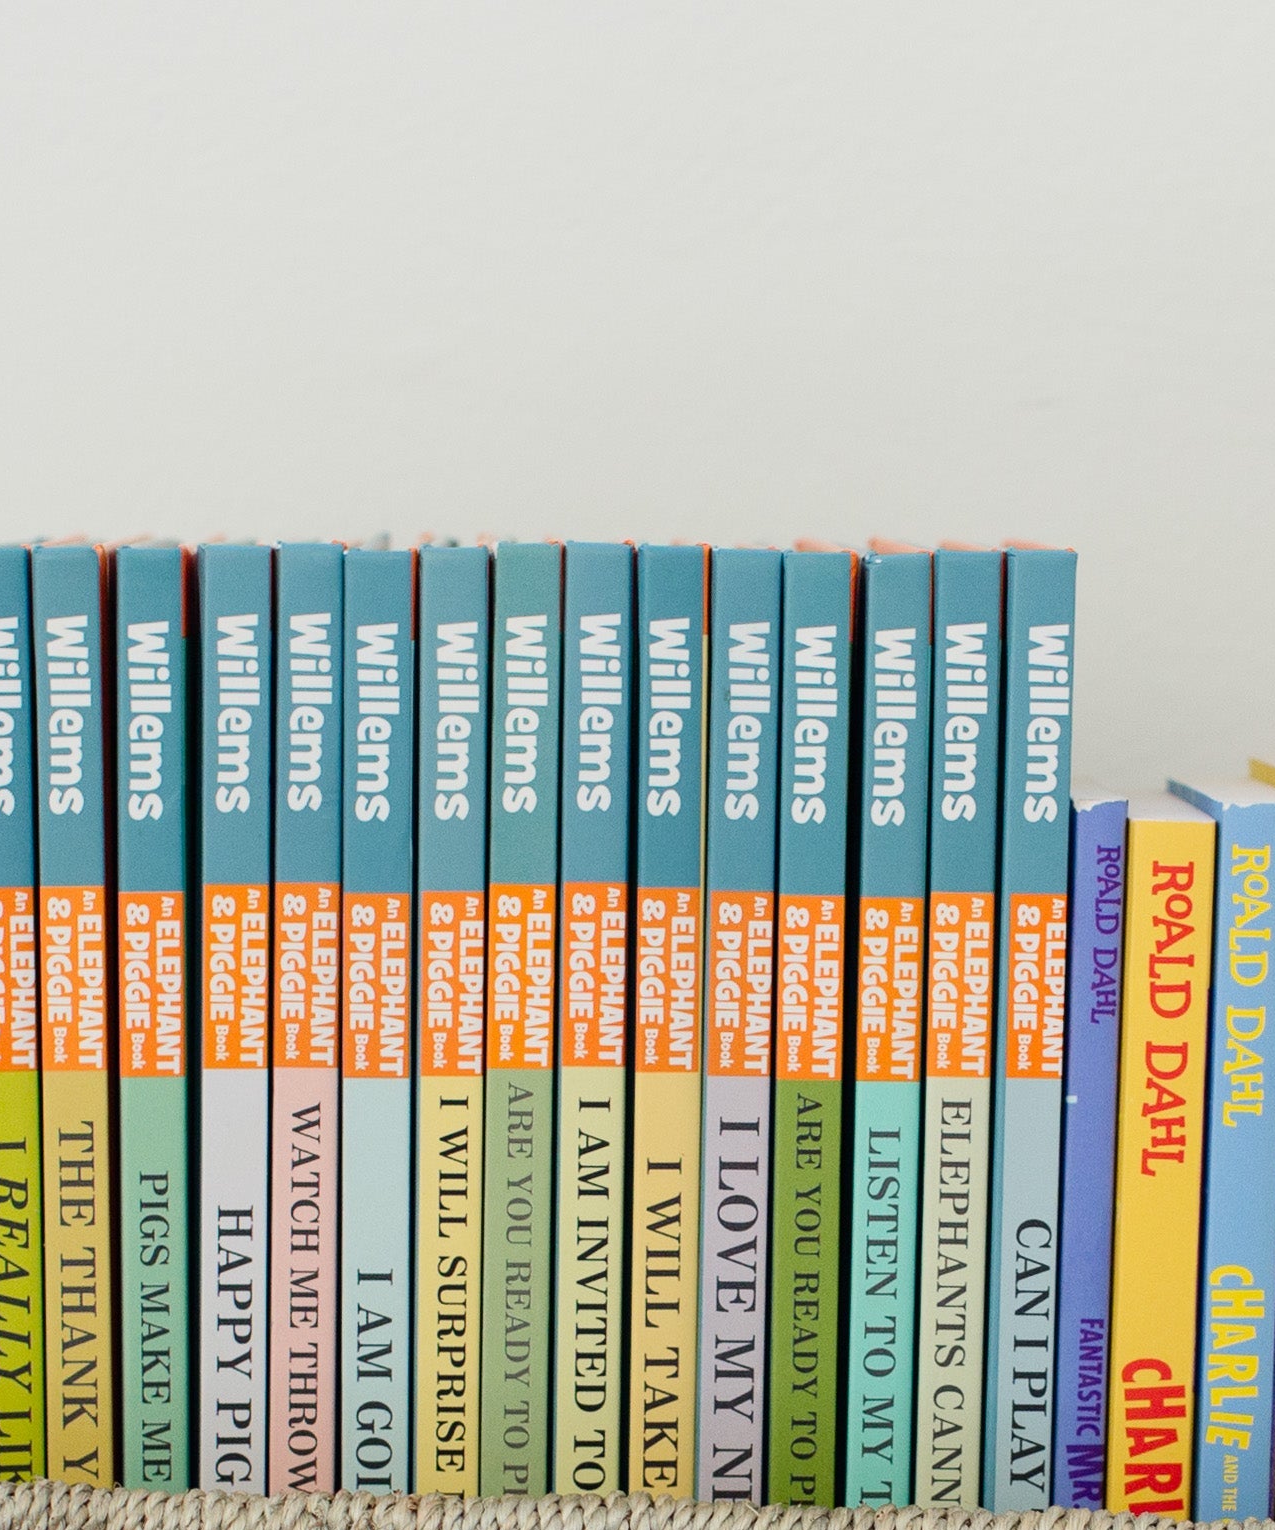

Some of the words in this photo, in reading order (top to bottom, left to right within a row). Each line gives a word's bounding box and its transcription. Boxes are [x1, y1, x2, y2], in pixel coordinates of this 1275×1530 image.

[46, 614, 92, 815] Willems
[127, 621, 172, 821] Willems
[215, 613, 260, 813] Willems
[287, 612, 333, 811] Willems
[354, 622, 400, 822] Willems
[434, 621, 480, 821] Willems
[501, 614, 549, 813] Willems
[576, 613, 623, 812] Willems
[646, 617, 692, 816] Willems
[724, 621, 771, 820] Willems
[791, 625, 838, 824] Willems
[870, 627, 917, 827] Willems
[941, 622, 989, 821] Willems
[1023, 623, 1070, 823] Willems
[47, 896, 72, 921] &
[82, 890, 96, 912] An
[125, 902, 150, 926] &
[161, 896, 175, 917] An
[212, 894, 236, 918] &
[247, 889, 261, 909] An
[351, 903, 376, 928] &
[387, 898, 401, 919] An
[497, 894, 522, 918] &
[533, 889, 547, 910] An
[641, 898, 666, 922] &
[677, 892, 691, 913] An
[785, 905, 810, 929] &
[821, 900, 835, 921] An
[935, 902, 960, 926] &
[971, 897, 985, 918] An
[1095, 845, 1120, 935] ROALD
[1228, 844, 1271, 986] ROALD
[45, 925, 73, 1023] PIGGIE
[124, 931, 151, 1029] PIGGIE
[209, 923, 236, 1021] PIGGIE
[348, 933, 376, 1030] PIGGIE
[494, 923, 522, 1021] PIGGIE
[639, 927, 666, 1025] PIGGIE
[782, 934, 810, 1032] PIGGIE
[931, 931, 960, 1029] PIGGIE
[1090, 947, 1118, 1024] DAHL
[1148, 861, 1194, 1019] ROALD
[77, 914, 104, 1069] ELEPHANT
[155, 920, 182, 1075] ELEPHANT
[240, 912, 267, 1067] ELEPHANT
[379, 921, 407, 1077] ELEPHANT
[524, 912, 552, 1067] ELEPHANT
[668, 916, 696, 1070] ELEPHANT
[811, 923, 840, 1078] ELEPHANT
[960, 921, 990, 1076] ELEPHANT
[53, 1026, 68, 1063] Book
[131, 1032, 146, 1069] Book
[215, 1024, 229, 1061] Book
[354, 1033, 370, 1070] Book
[499, 1024, 514, 1061] Book
[644, 1028, 659, 1064] Book
[787, 1035, 802, 1072] Book
[936, 1033, 951, 1069] Book
[1223, 1006, 1266, 1127] DAHL
[439, 1095, 469, 1110] I
[507, 1082, 534, 1159] ARE
[579, 1096, 611, 1112] I
[719, 1117, 760, 1136] I
[796, 1093, 823, 1170] ARE
[1141, 1042, 1188, 1177] DAHL
[58, 1120, 96, 1227] THE
[290, 1102, 321, 1253] WATCH
[438, 1126, 469, 1238] WILL
[505, 1174, 533, 1246] YOU
[577, 1129, 610, 1198] AM
[647, 1156, 682, 1175] I
[139, 1173, 170, 1267] PIGS
[644, 1193, 682, 1329] WILL
[715, 1157, 759, 1313] LOVE
[793, 1184, 822, 1258] YOU
[865, 1128, 901, 1300] LISTEN
[934, 1100, 972, 1368] ELEPHANTS
[216, 1207, 253, 1380] HAPPY
[289, 1268, 319, 1329] ME
[357, 1269, 393, 1285] I
[574, 1219, 609, 1413] INVITED
[1014, 1219, 1052, 1319] CAN
[60, 1246, 99, 1430] THANK
[140, 1283, 171, 1404] MAKE
[356, 1303, 393, 1381] AM
[435, 1256, 467, 1472] SURPRISE
[504, 1261, 531, 1388] READY
[792, 1272, 820, 1398] READY
[863, 1315, 897, 1378] TO
[1013, 1335, 1049, 1352] I
[1205, 1265, 1265, 1450] CHARLIE
[287, 1342, 318, 1495] THROW
[503, 1400, 530, 1450] TO
[642, 1346, 680, 1489] TAKE
[713, 1335, 756, 1424] MY
[1076, 1318, 1104, 1436] FANTASTIC
[63, 1447, 99, 1479] Y
[142, 1421, 172, 1483] ME
[215, 1401, 252, 1485] PIG
[572, 1429, 606, 1491] TO
[790, 1411, 817, 1461] TO
[861, 1395, 895, 1465] MY
[930, 1384, 964, 1505] CANN
[1009, 1369, 1048, 1493] PLAY
[1222, 1455, 1238, 1484] AND
[1222, 1487, 1237, 1510] THE
